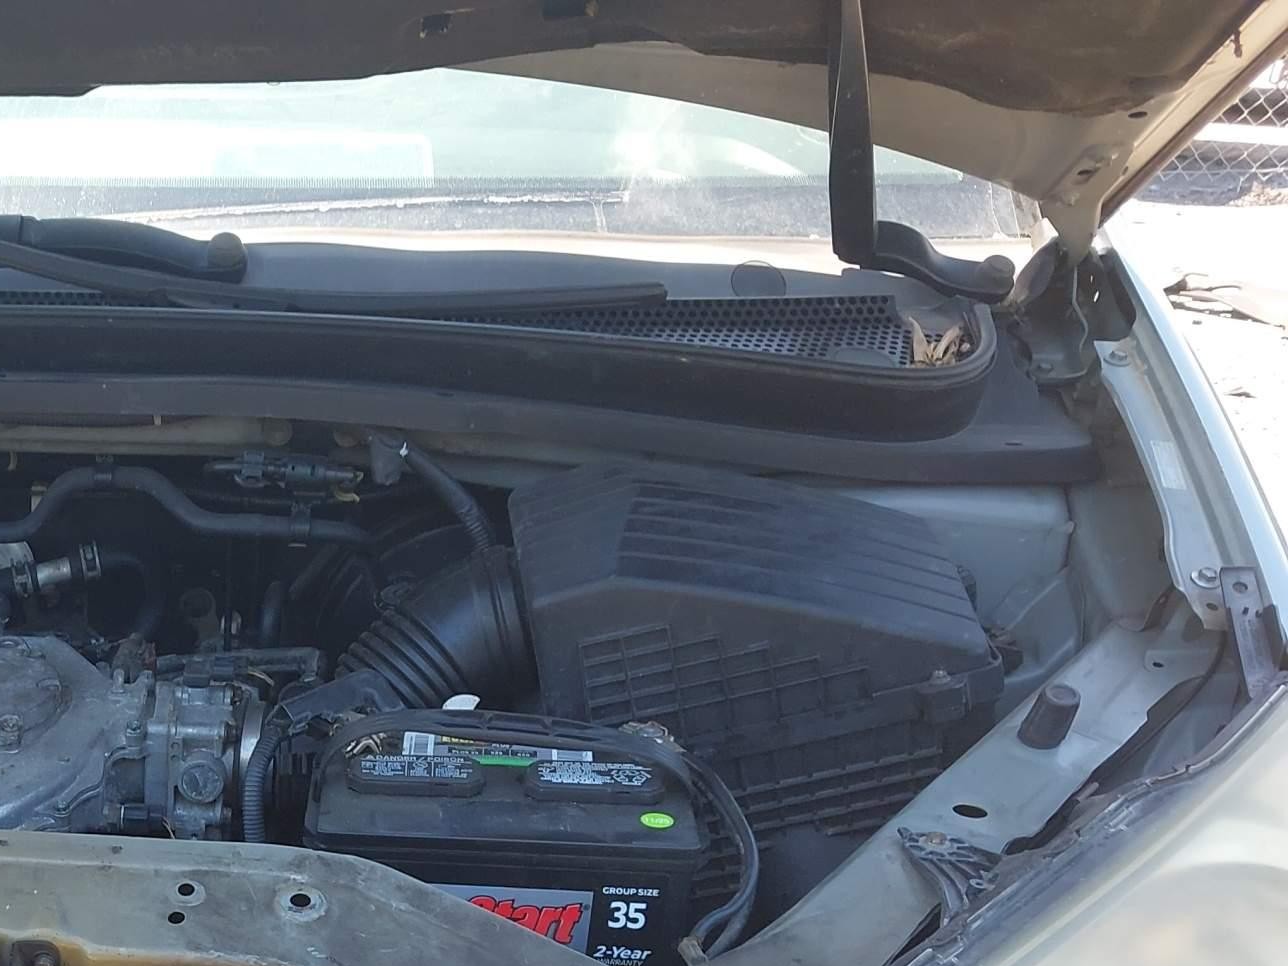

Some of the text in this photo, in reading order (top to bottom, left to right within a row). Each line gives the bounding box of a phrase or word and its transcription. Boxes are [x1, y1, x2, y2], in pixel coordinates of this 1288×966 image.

[374, 754, 465, 764] DANGER POISON
[601, 885, 660, 897] GROUP SIZE
[607, 900, 648, 930] 35
[592, 944, 652, 961] 2-Year
